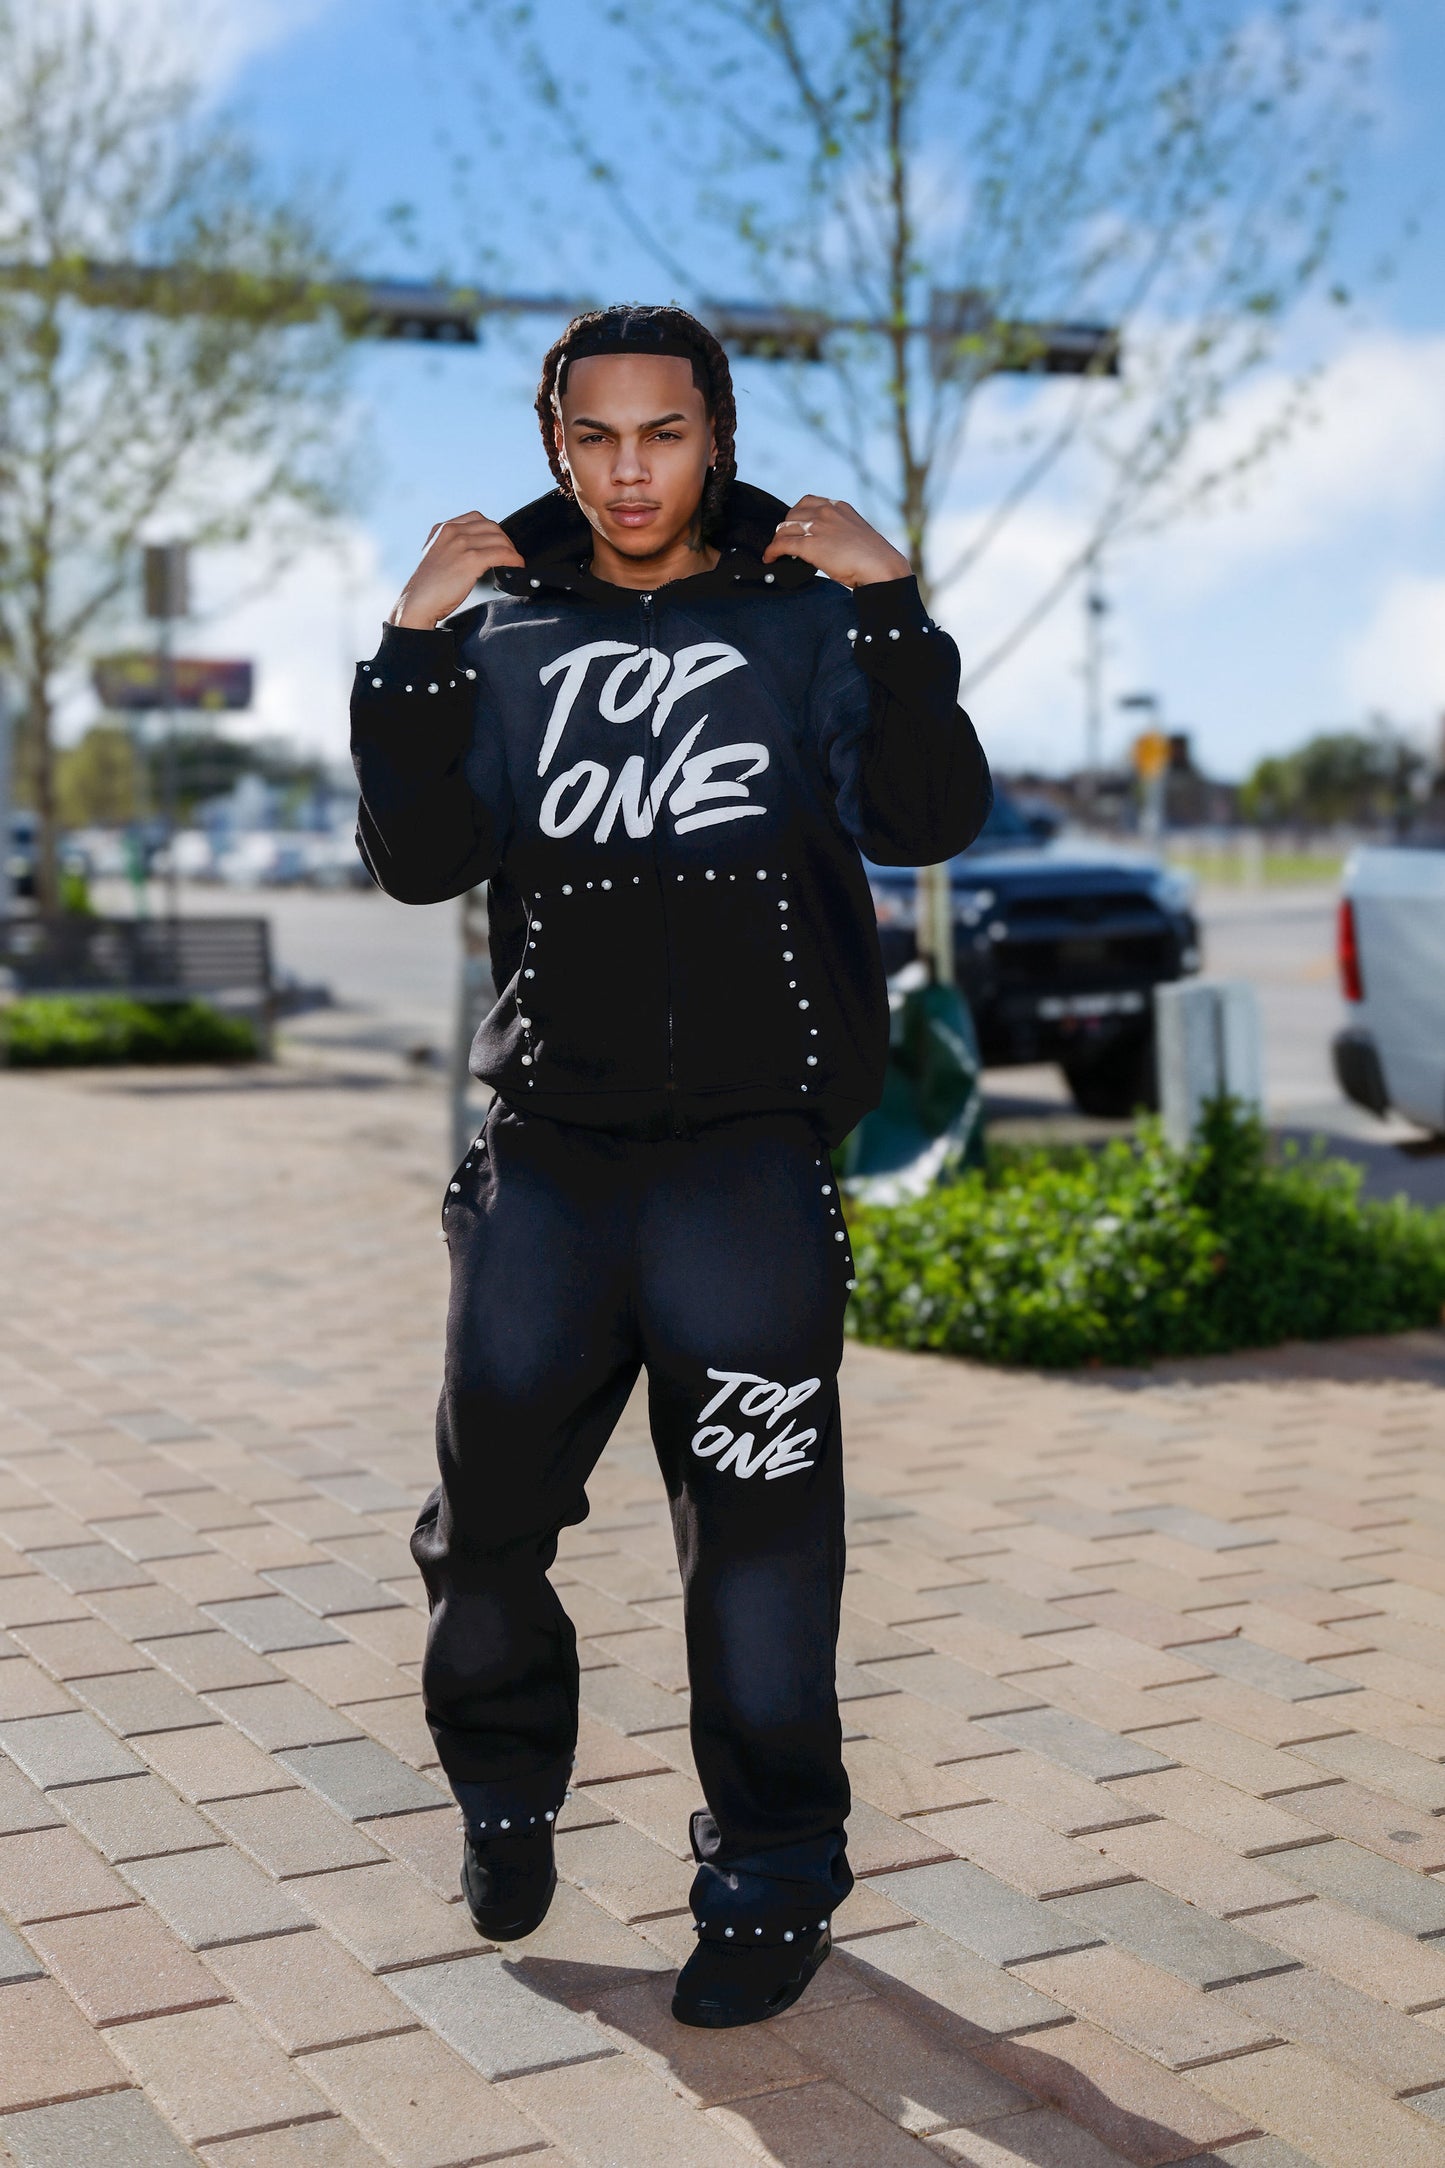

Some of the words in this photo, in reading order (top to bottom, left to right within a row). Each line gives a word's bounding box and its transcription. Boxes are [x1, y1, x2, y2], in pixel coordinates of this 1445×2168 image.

[537, 640, 749, 778] TOP
[538, 713, 770, 844] ONE
[696, 1367, 821, 1430] TOP
[691, 1418, 818, 1481] ONE
